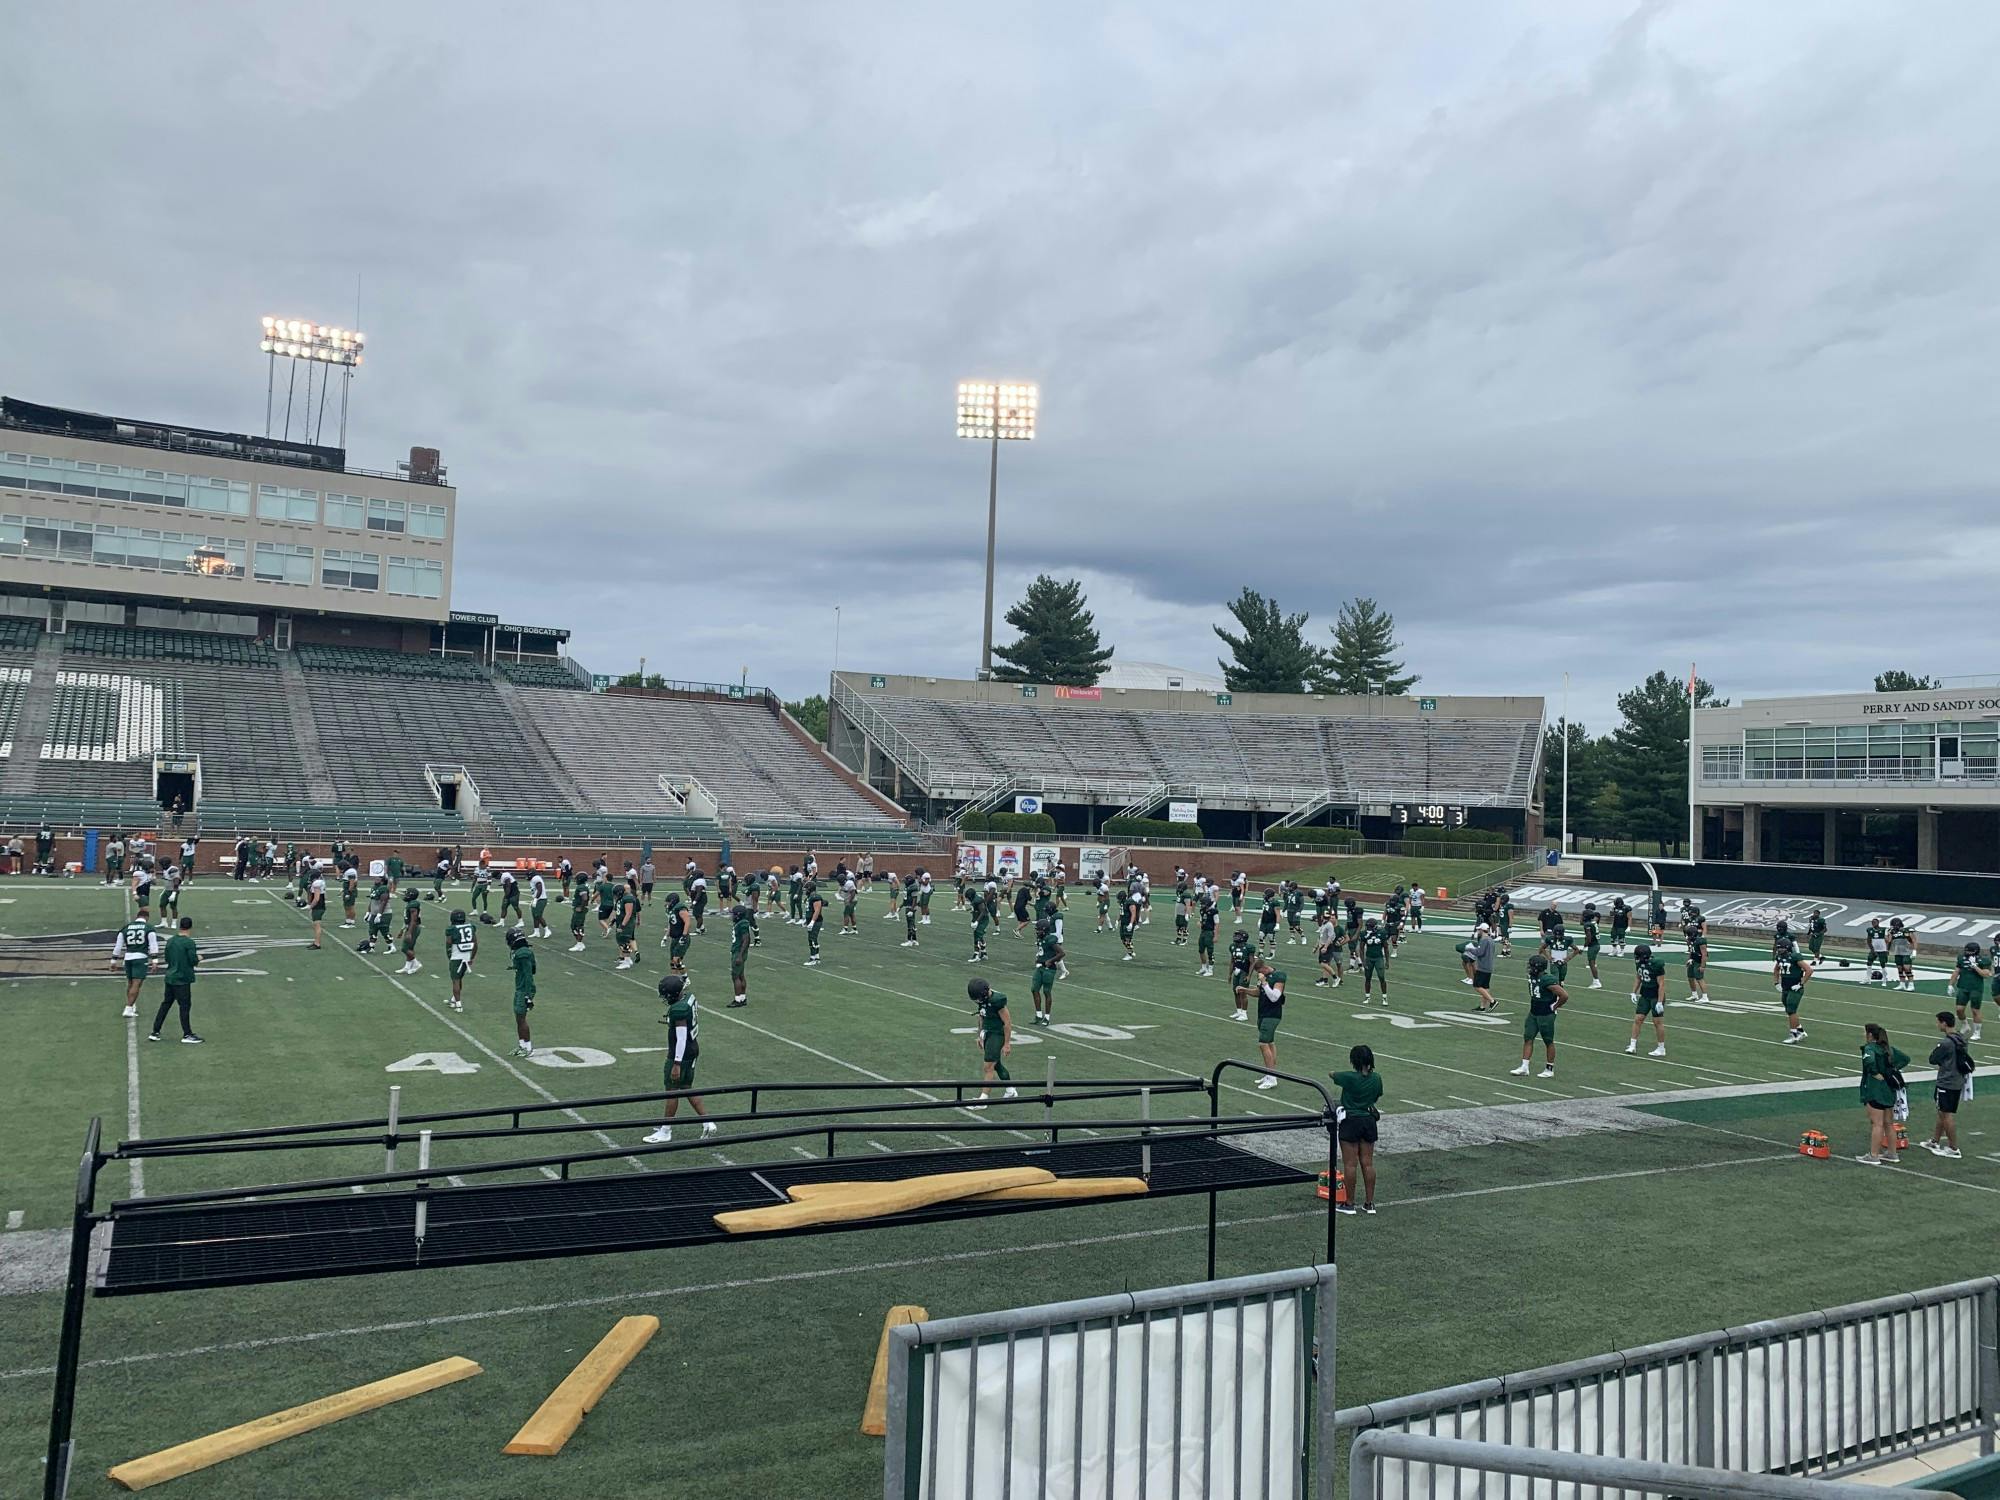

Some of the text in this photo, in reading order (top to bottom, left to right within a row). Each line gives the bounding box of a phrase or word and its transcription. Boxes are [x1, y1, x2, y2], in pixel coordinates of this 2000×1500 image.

[451, 613, 476, 622] TOWER
[504, 625, 557, 635] OHIO BOBCATS
[1863, 703, 1901, 714] PERRY
[1903, 702, 1930, 713] AND
[1933, 700, 1975, 711] SANDY
[1400, 810, 1408, 823] 3
[1418, 805, 1444, 818] 4:00
[1455, 811, 1463, 825] 3
[126, 930, 146, 945] 23
[459, 927, 473, 943] 13
